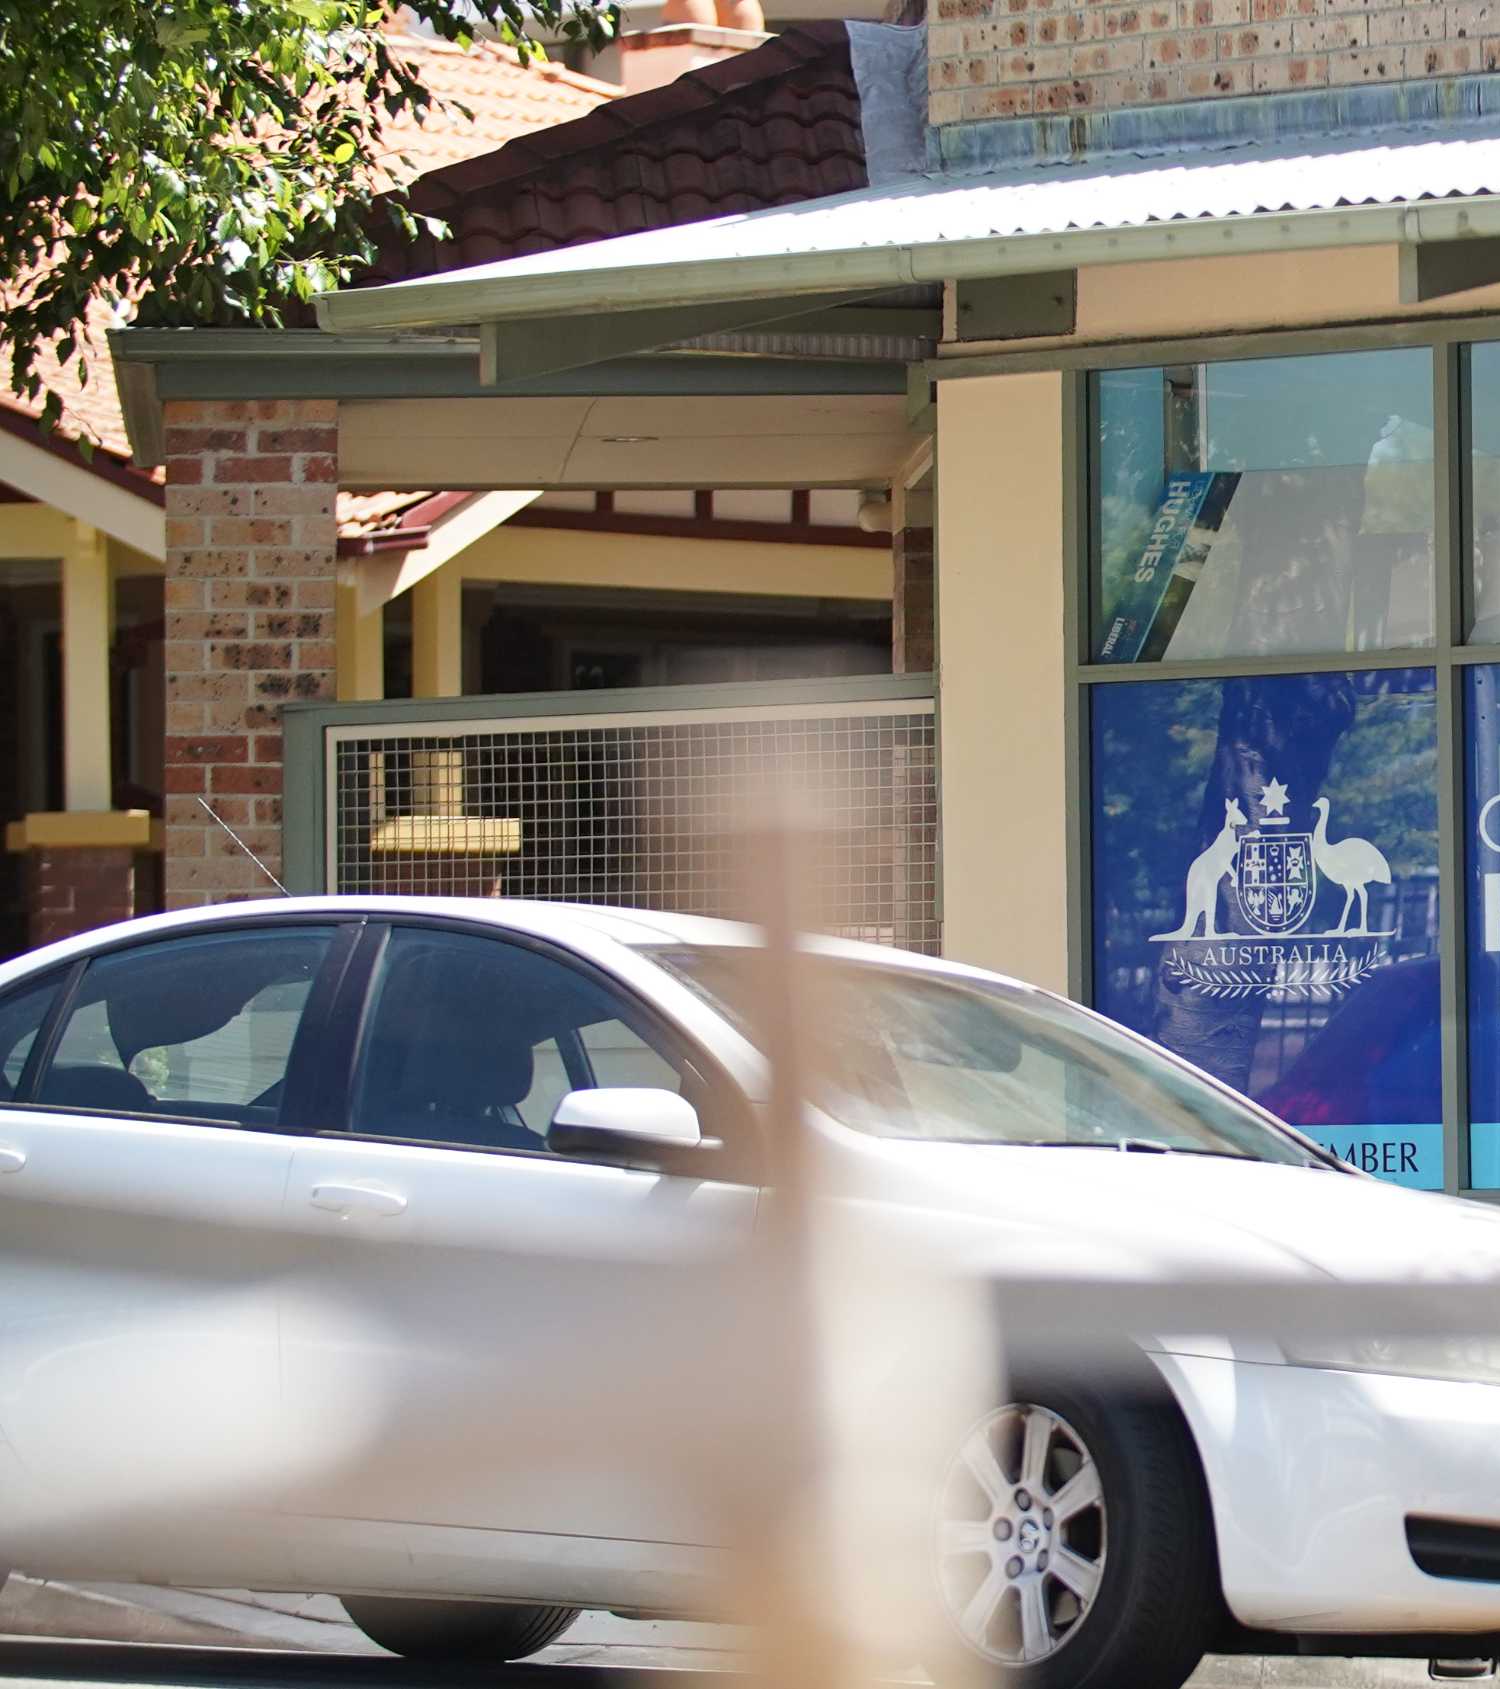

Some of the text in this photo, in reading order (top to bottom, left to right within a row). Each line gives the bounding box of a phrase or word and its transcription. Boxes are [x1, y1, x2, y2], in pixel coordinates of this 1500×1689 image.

[1135, 481, 1191, 583] HUGHES
[1101, 617, 1125, 657] LIBERAL
[1203, 944, 1349, 966] AUSTRALIA
